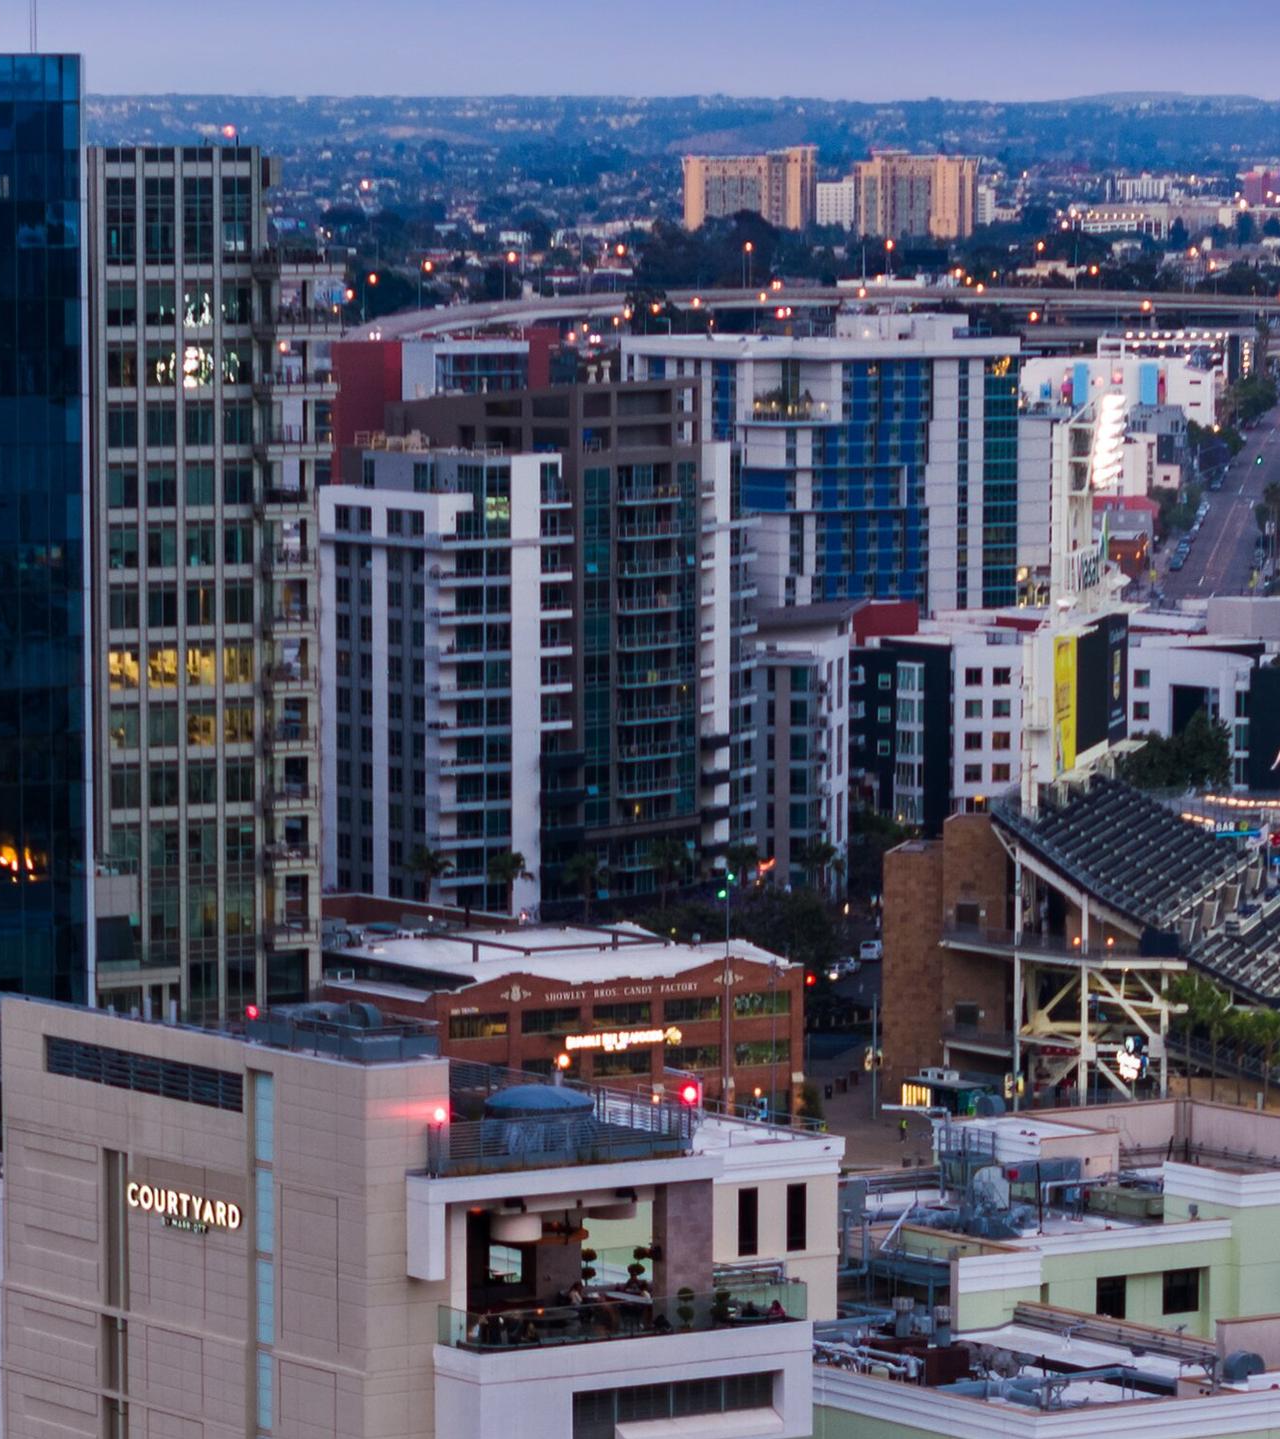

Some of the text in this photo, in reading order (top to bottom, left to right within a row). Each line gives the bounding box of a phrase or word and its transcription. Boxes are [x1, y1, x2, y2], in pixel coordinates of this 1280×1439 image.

[545, 991, 586, 1002] SHOWLEY
[624, 986, 653, 996] CANDY
[660, 983, 699, 993] FACTORY
[127, 1182, 242, 1230] COURTYARD
